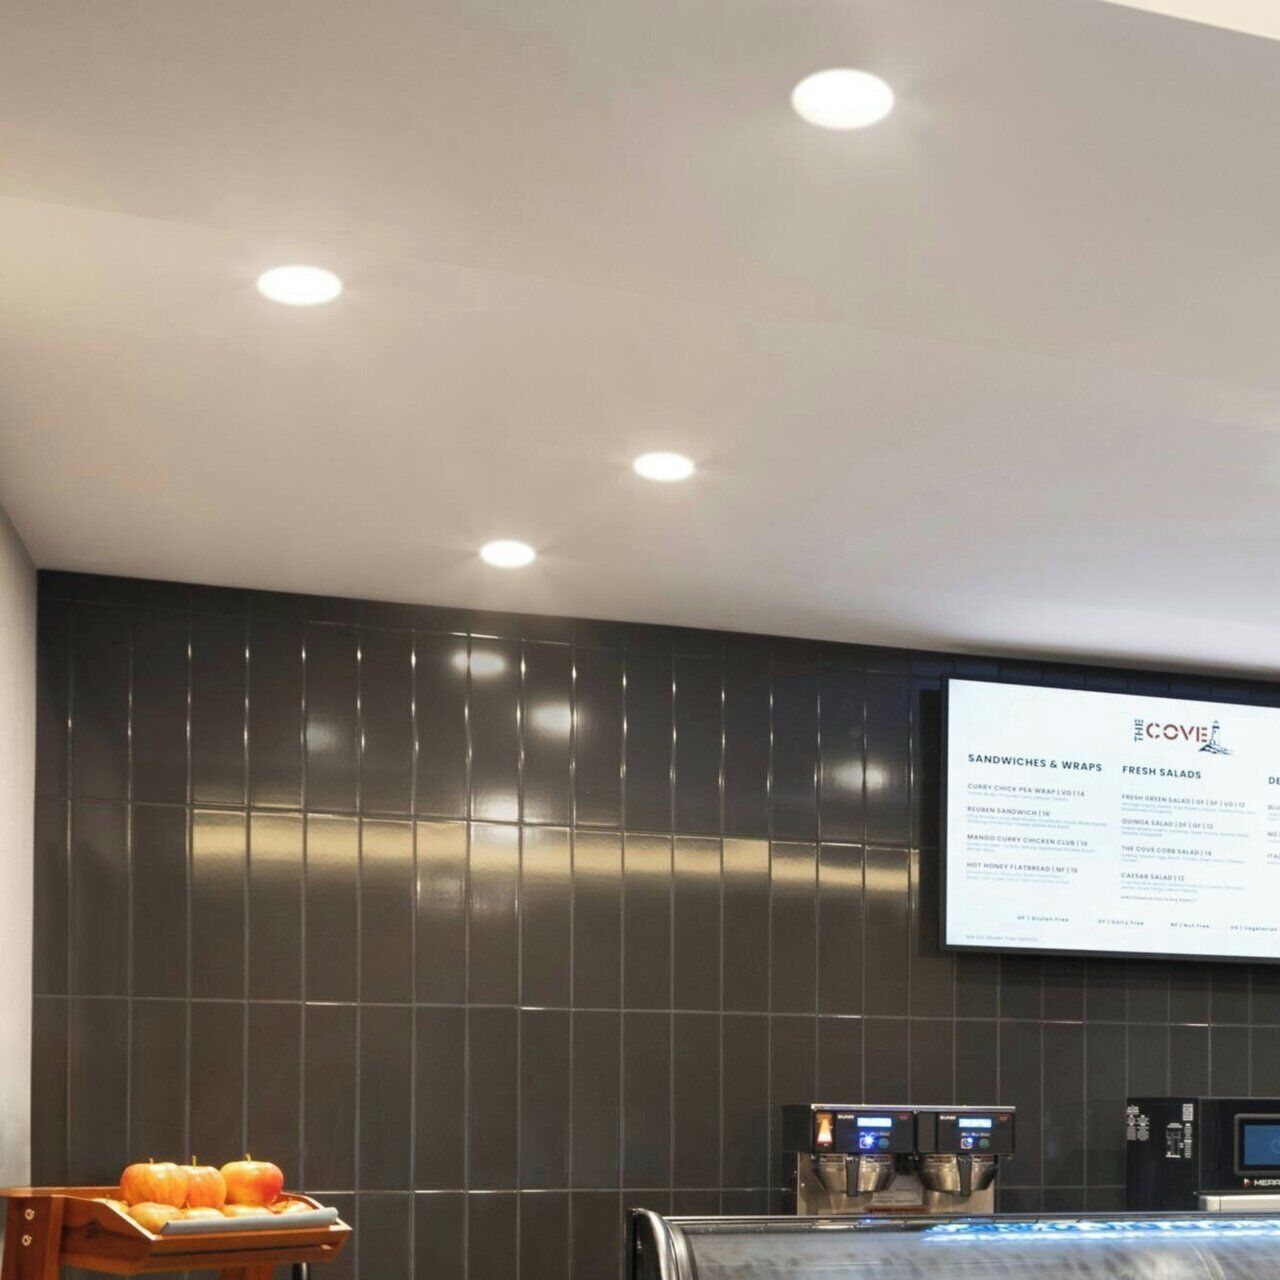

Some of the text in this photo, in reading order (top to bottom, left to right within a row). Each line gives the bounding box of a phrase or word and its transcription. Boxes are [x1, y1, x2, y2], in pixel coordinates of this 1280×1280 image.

[1134, 719, 1144, 742] THE
[1146, 722, 1208, 743] COVE
[968, 753, 1103, 772] SANDWICHES & WRAPS
[1122, 765, 1202, 779] FRESH SALADS
[967, 783, 993, 791] CURRY
[994, 784, 1017, 792] CHICK
[997, 808, 1038, 816] SANDWICH
[1121, 818, 1150, 826] QUINOA
[997, 835, 1022, 843] CURRY
[1023, 837, 1056, 845] CHICKEN
[1177, 848, 1199, 856] SALAD
[966, 861, 982, 869] HOT
[1010, 864, 1051, 872] FLATBREAD
[1120, 872, 1149, 880] CAESAR
[1150, 873, 1173, 881] SALAD
